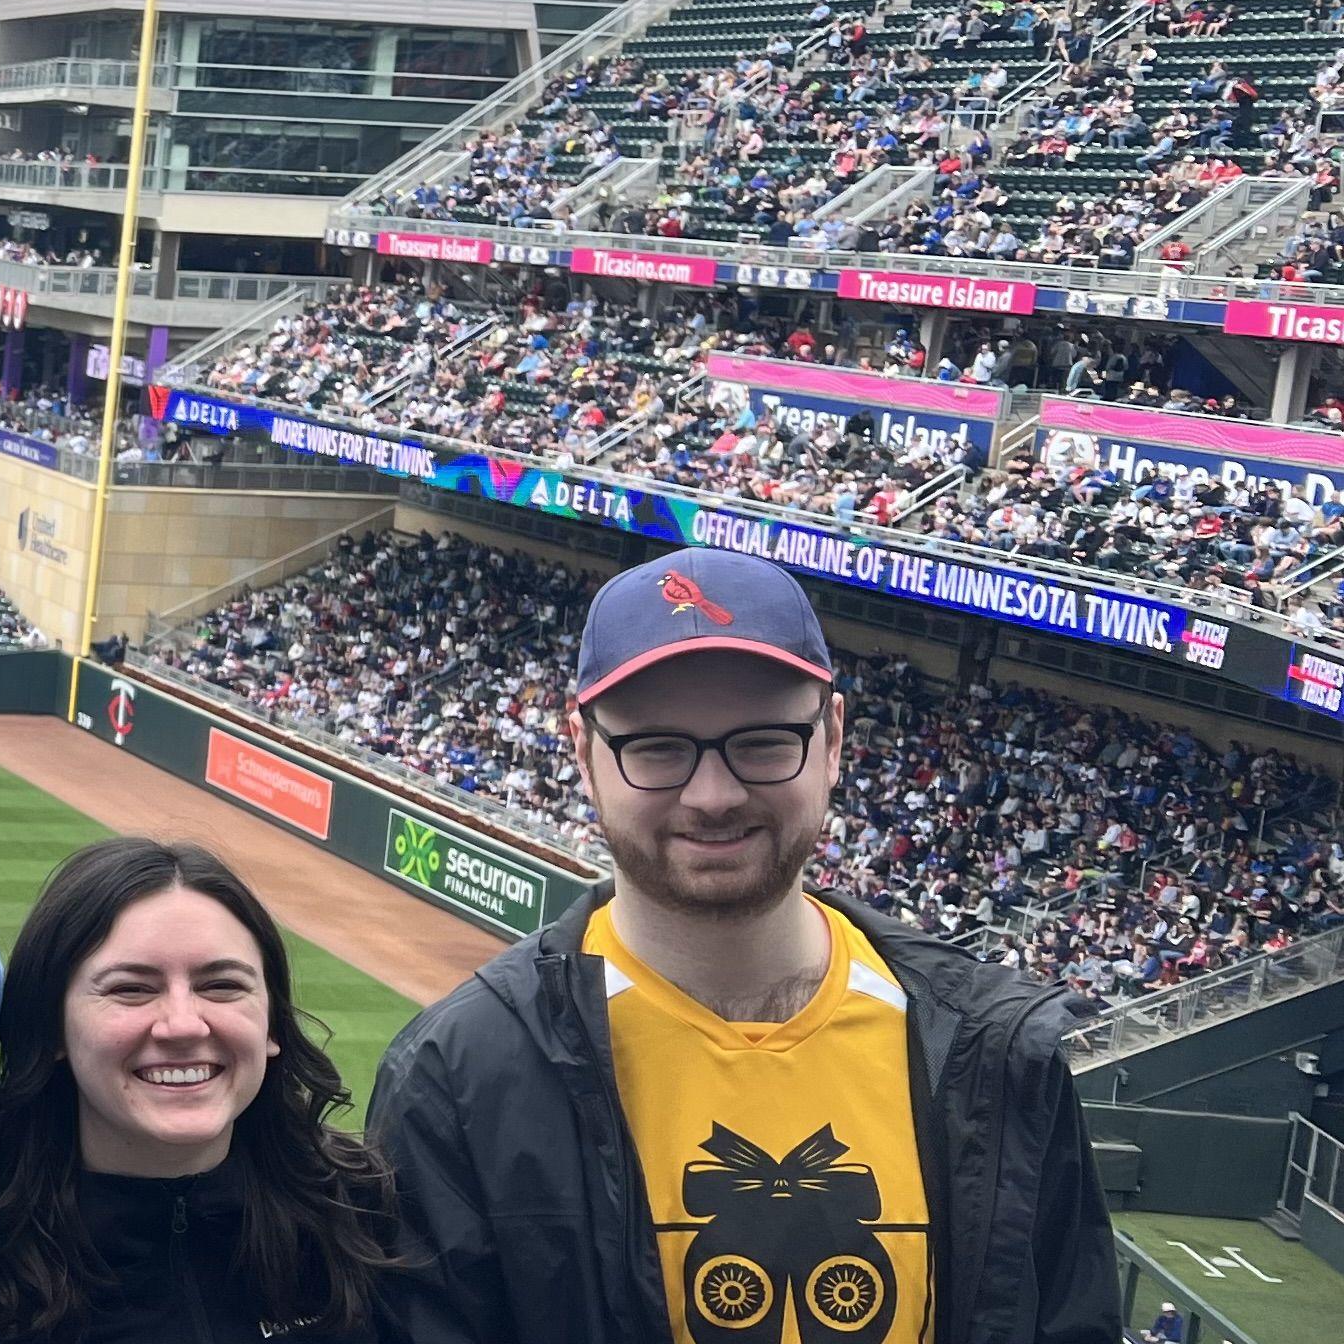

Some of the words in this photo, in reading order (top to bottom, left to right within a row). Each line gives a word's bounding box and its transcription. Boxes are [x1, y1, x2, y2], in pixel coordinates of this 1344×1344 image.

[388, 233, 439, 259] Treasure
[440, 238, 480, 263] Island
[858, 272, 943, 306] Treasure
[948, 280, 1014, 313] Island
[189, 402, 238, 430] DELTA
[271, 417, 305, 447] MORE
[305, 425, 338, 456] WINS
[339, 431, 363, 462] FOR
[365, 436, 390, 468] THE
[555, 481, 631, 521] DELTA
[693, 510, 771, 559] OFFICIAL
[774, 529, 856, 577] AIRLINE
[857, 546, 887, 584] OF
[888, 551, 934, 596] THE
[934, 561, 1077, 628] MINNESOTA
[1085, 593, 1172, 653] TWINS.
[1192, 618, 1230, 648] PITCH
[1186, 641, 1225, 670] SPEED
[444, 874, 504, 915] FINANCIAL
[446, 848, 533, 908] securian
